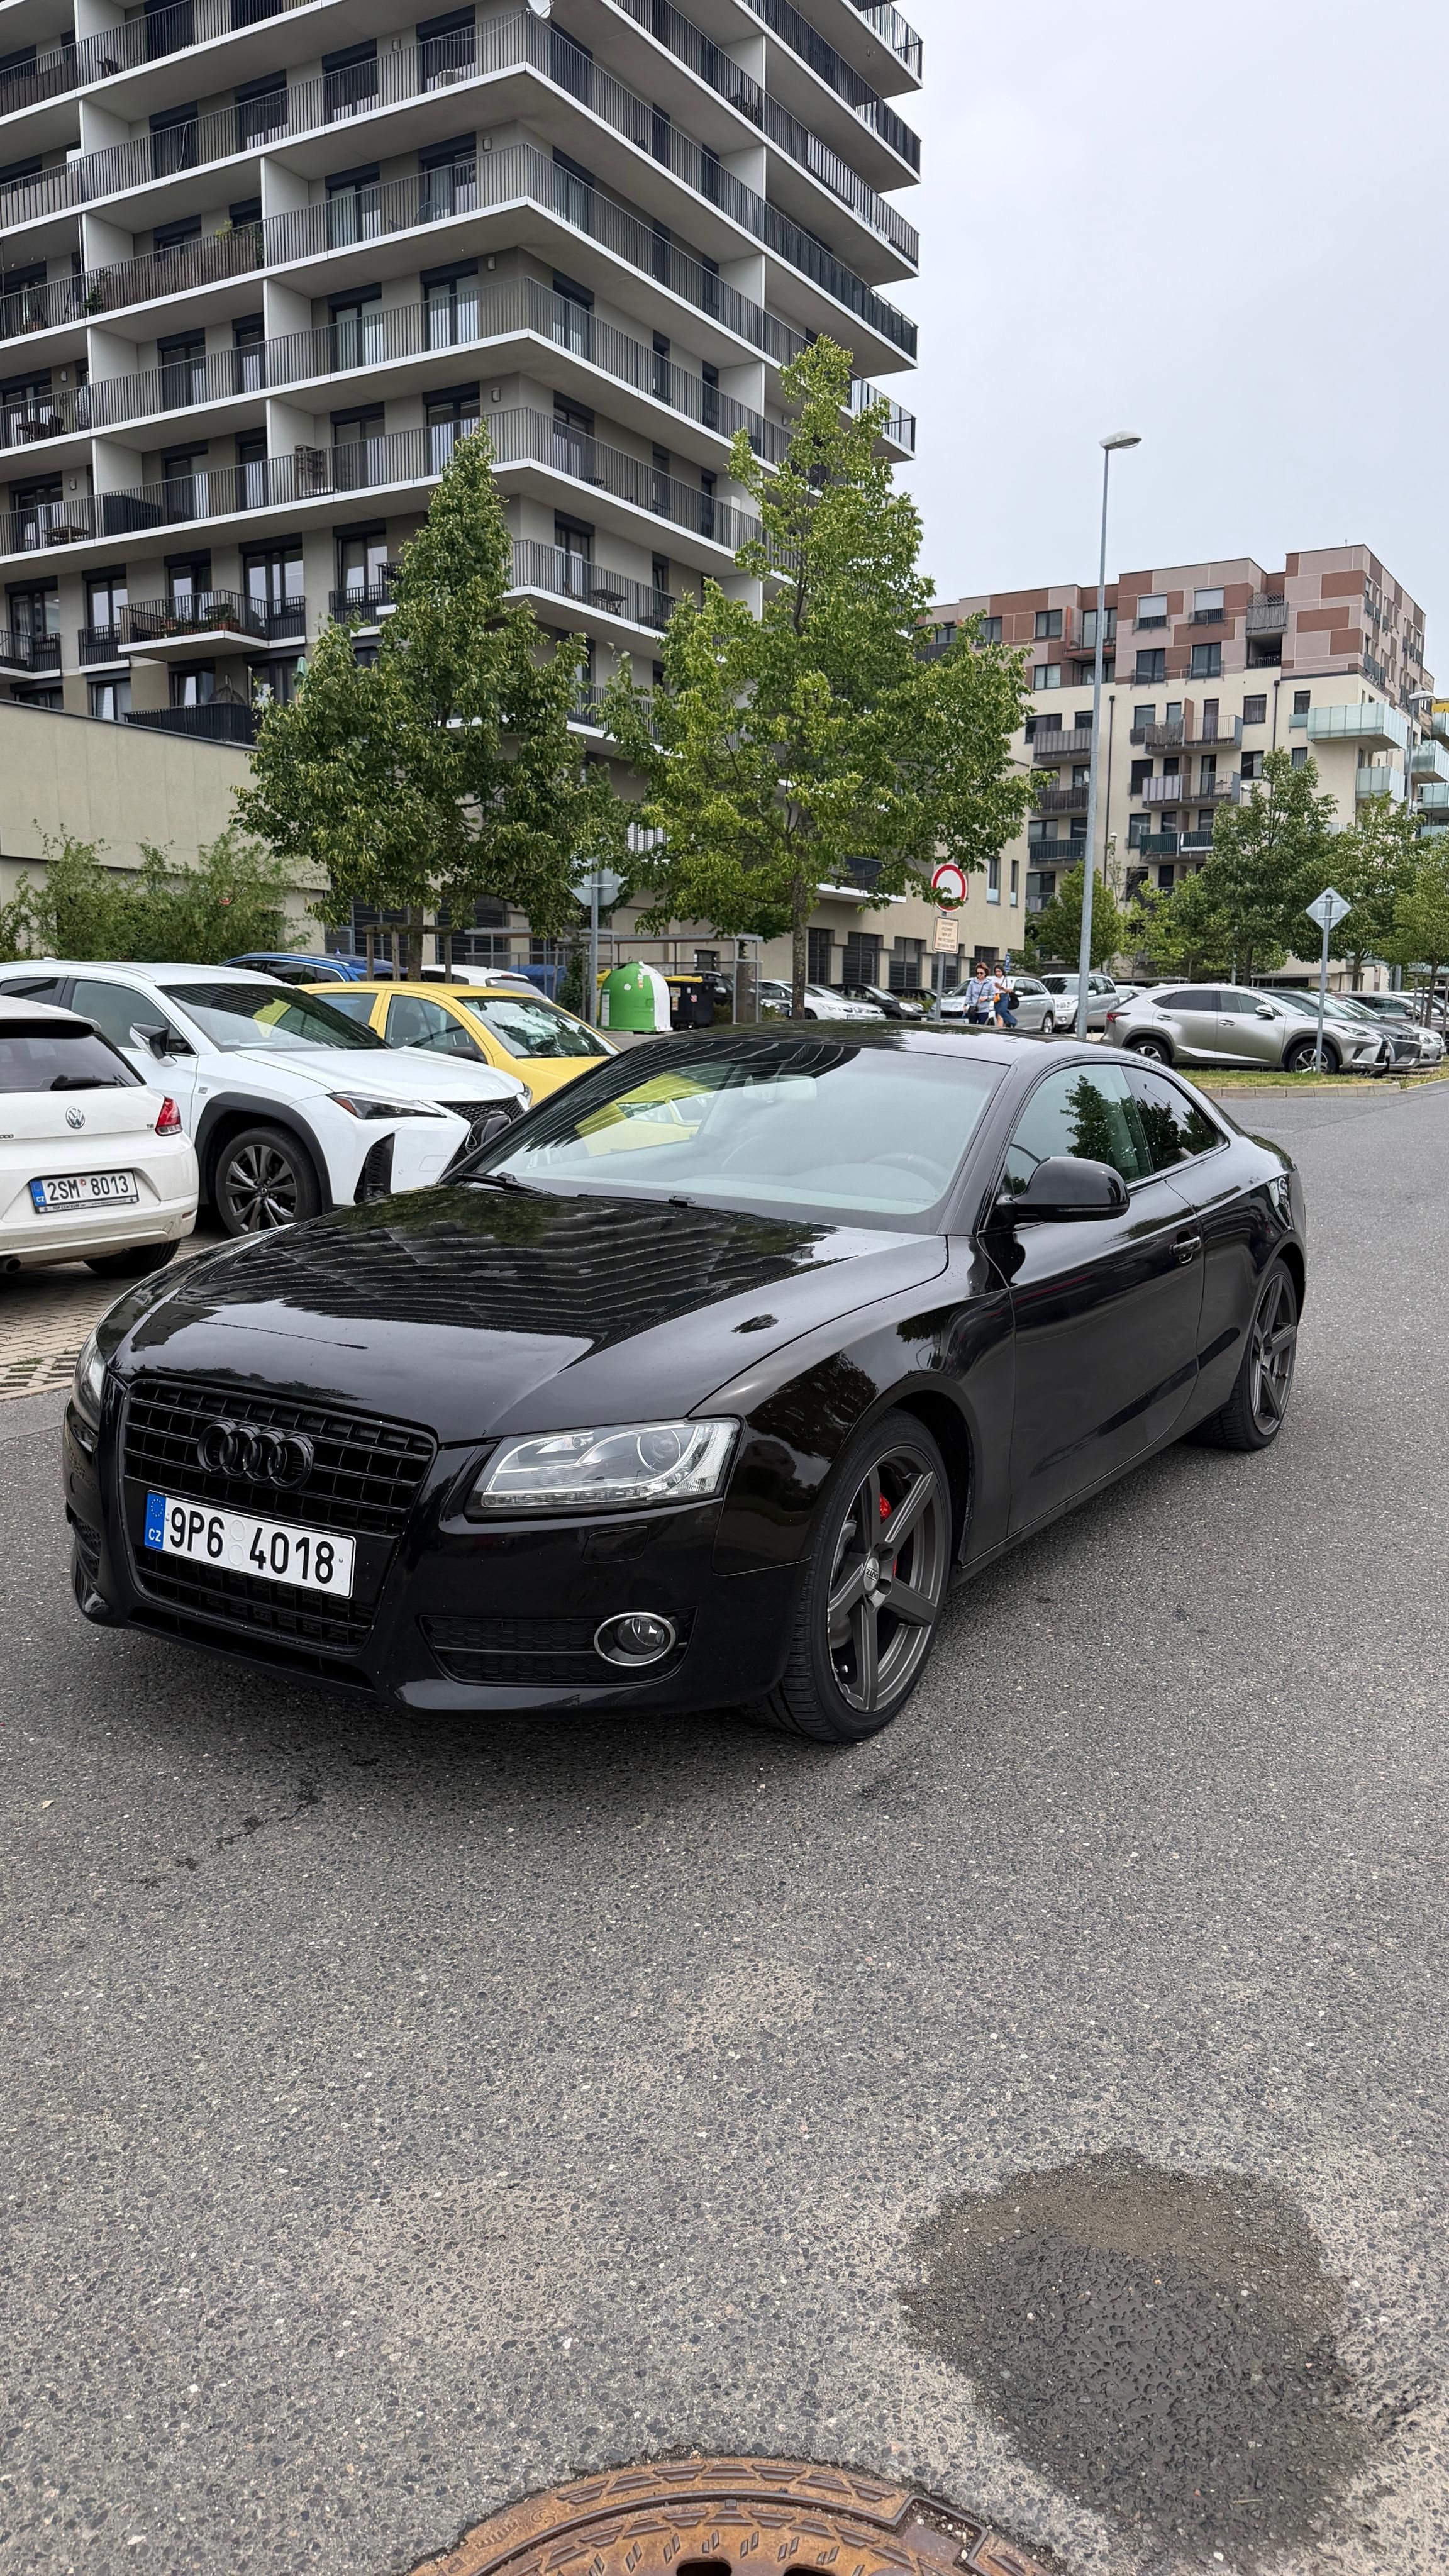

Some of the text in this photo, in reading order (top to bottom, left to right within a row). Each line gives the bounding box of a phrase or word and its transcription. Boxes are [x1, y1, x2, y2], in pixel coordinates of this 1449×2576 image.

[47, 1175, 128, 1201] 2SM 8013
[148, 1528, 161, 1542] CZ
[170, 1507, 335, 1584] 9P6 4018
